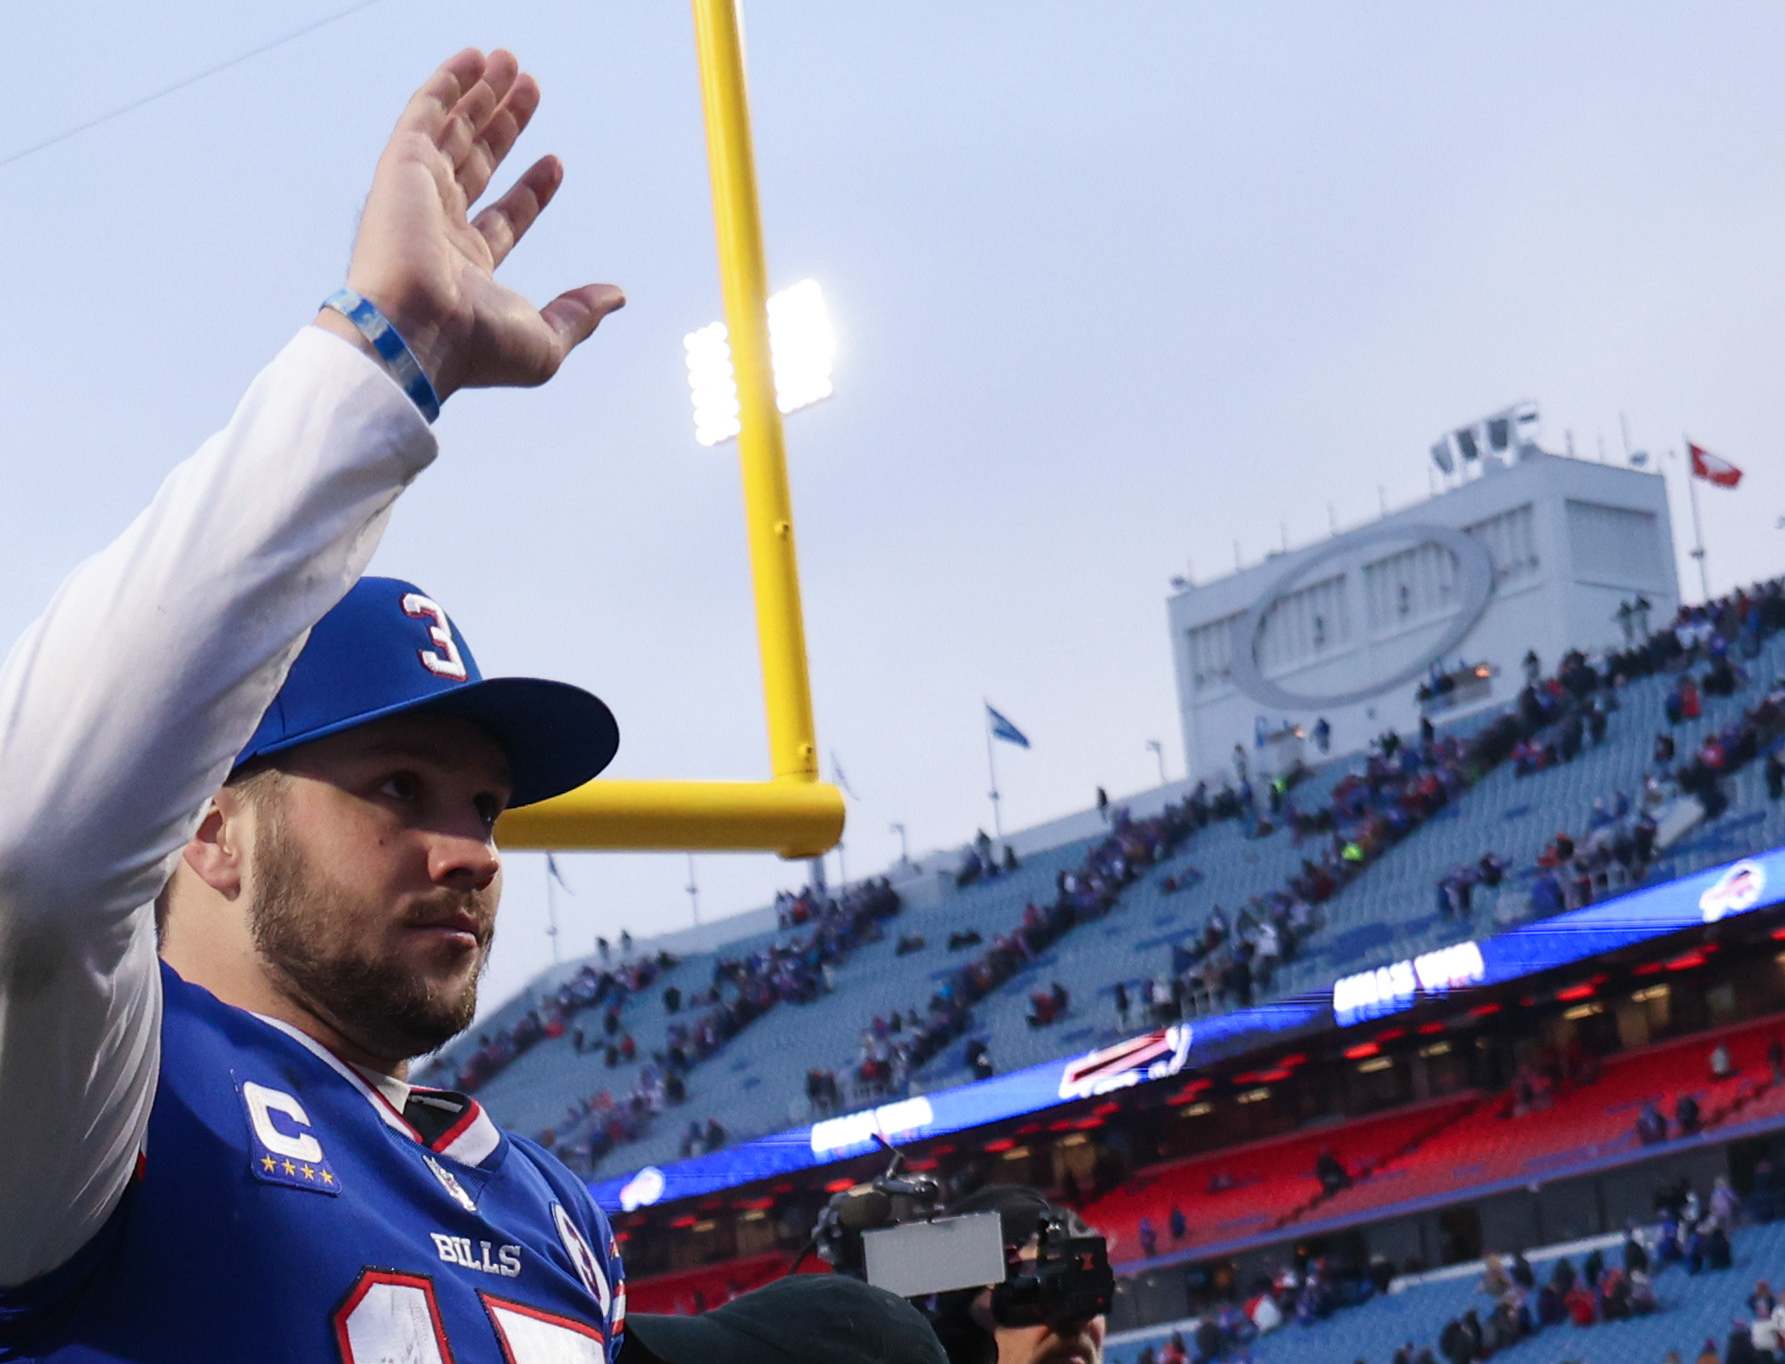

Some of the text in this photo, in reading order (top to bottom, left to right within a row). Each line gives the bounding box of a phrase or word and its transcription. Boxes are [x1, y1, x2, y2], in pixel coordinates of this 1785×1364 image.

[400, 592, 469, 683] 3
[243, 1081, 324, 1164] C
[430, 1232, 522, 1278] BILLS
